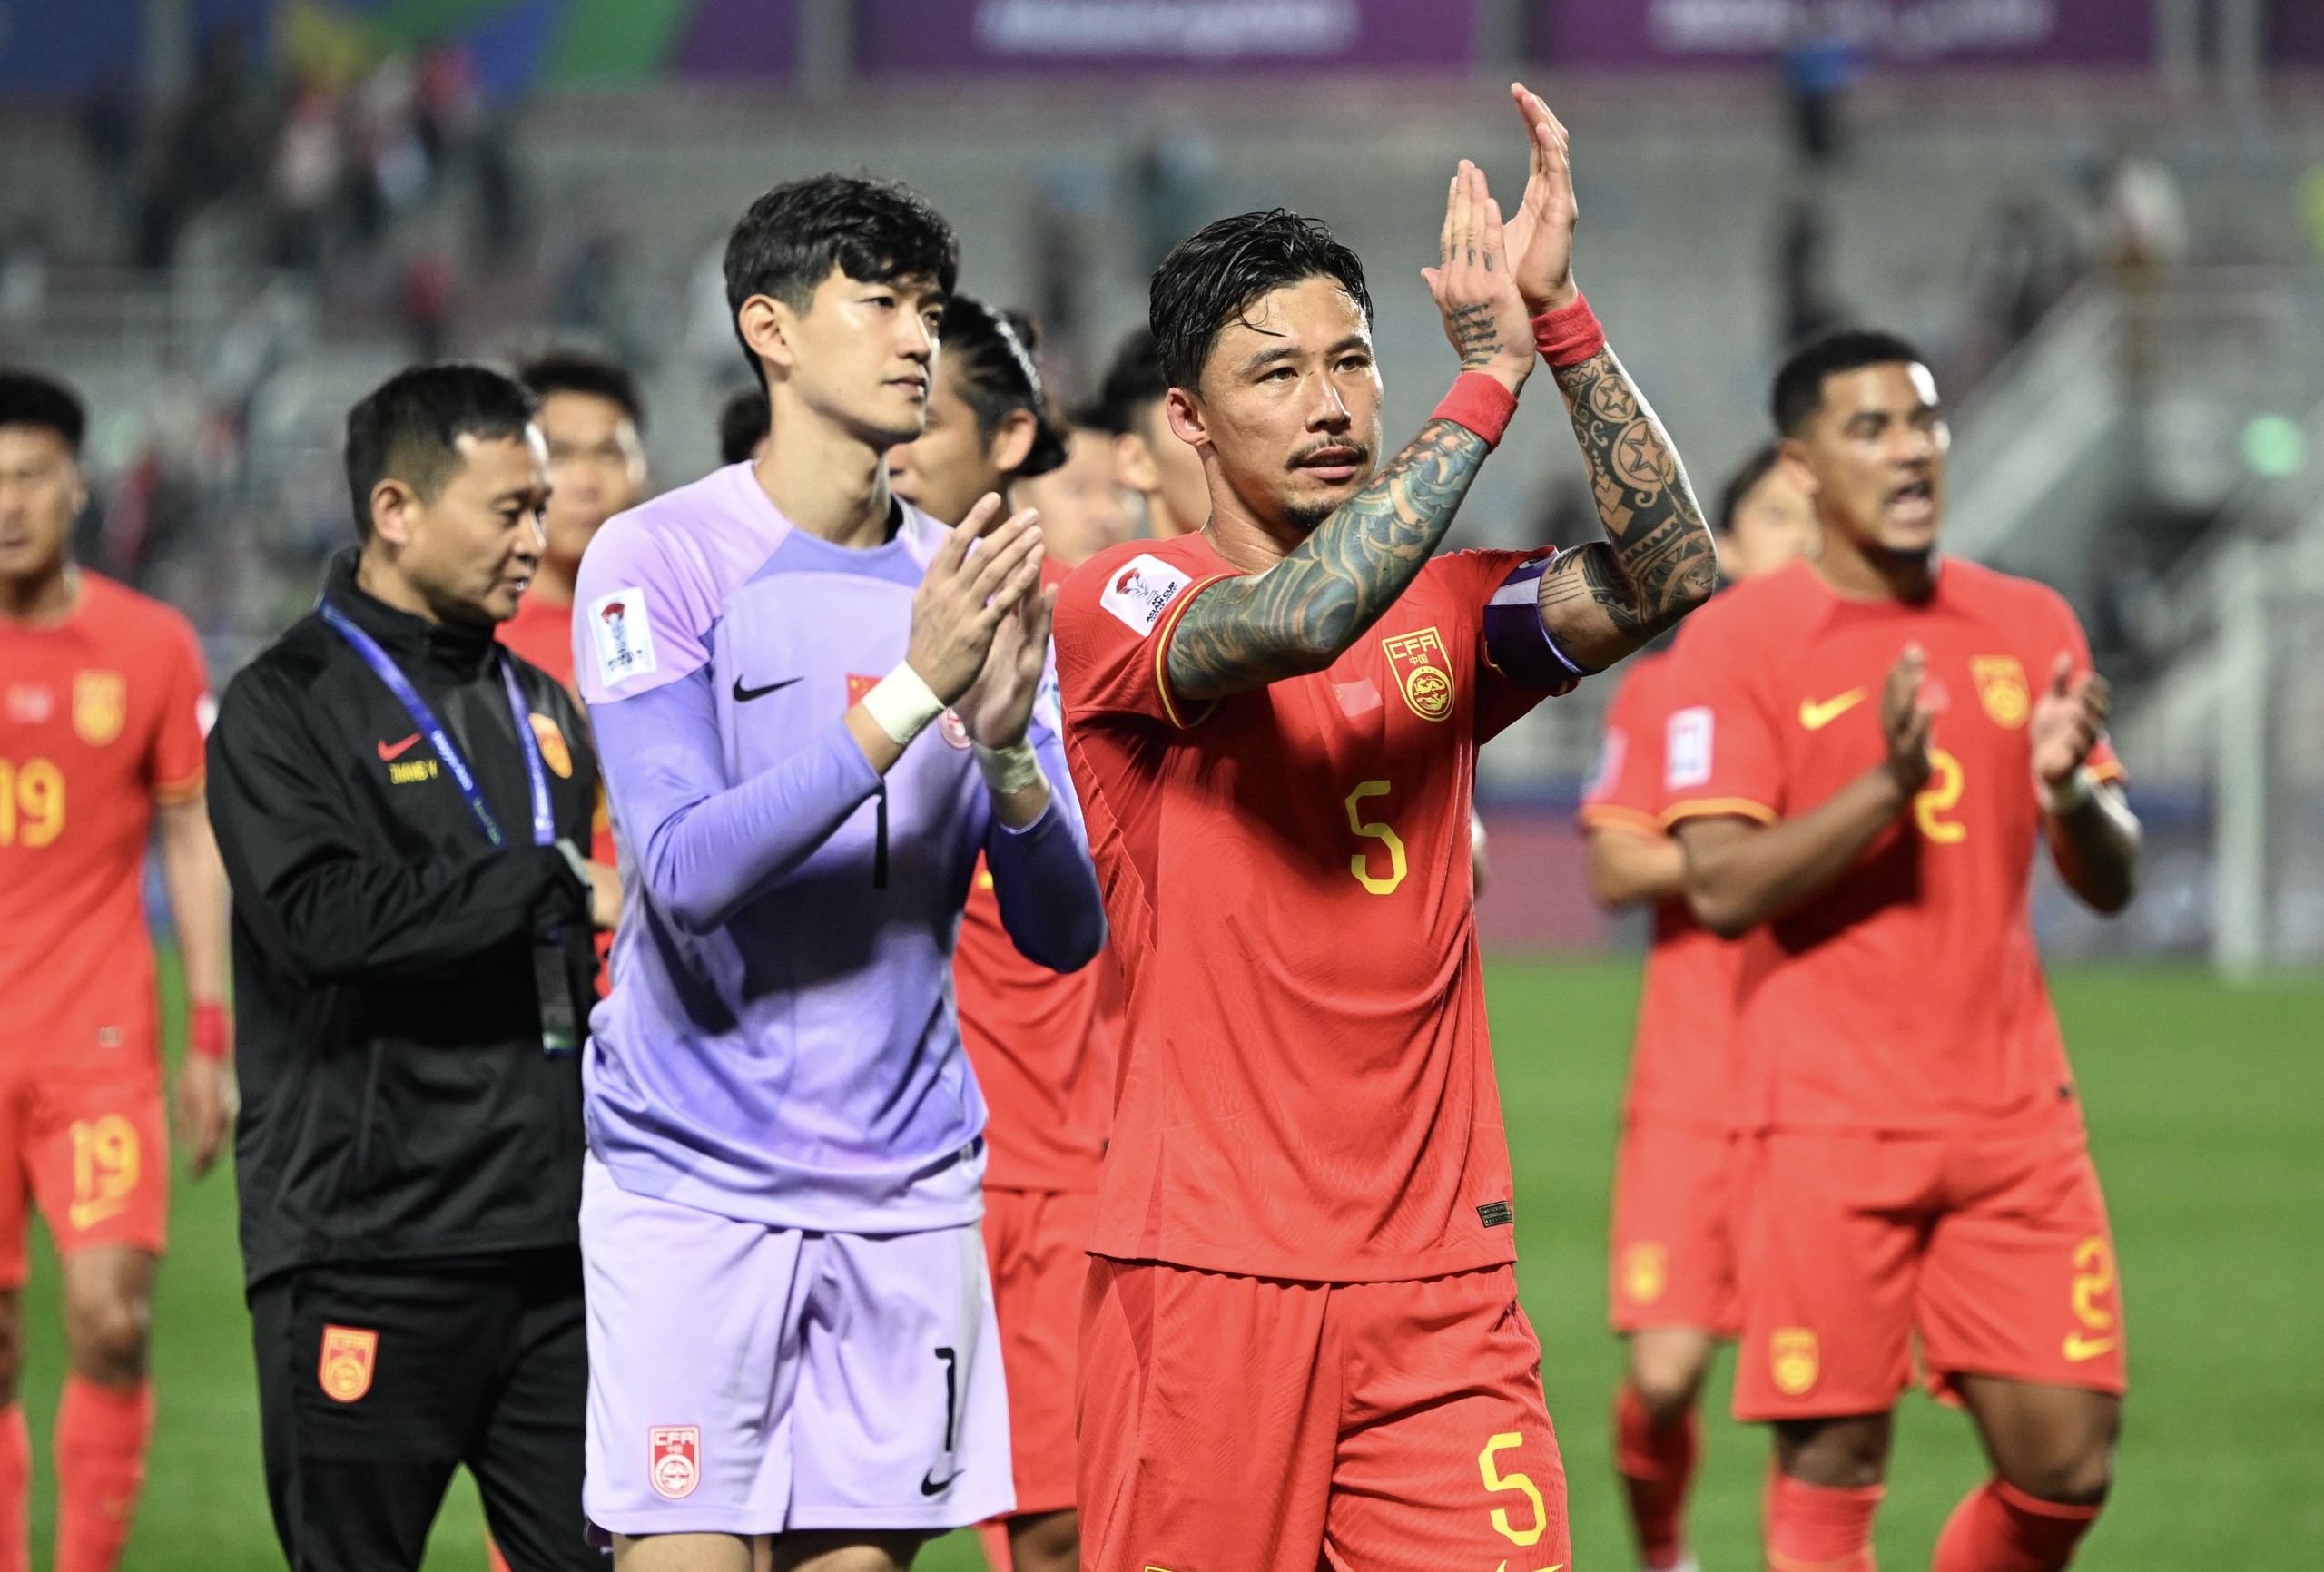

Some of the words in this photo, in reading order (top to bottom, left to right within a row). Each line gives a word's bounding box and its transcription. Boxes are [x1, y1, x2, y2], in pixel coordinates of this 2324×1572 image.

[1146, 598, 1165, 624] ASIAN
[1162, 581, 1176, 598] CUP
[1152, 593, 1162, 606] AFC
[1388, 634, 1438, 660] CFA
[0, 756, 66, 849] 19
[1344, 779, 1408, 896] 5
[1913, 747, 1968, 845] 2
[67, 1113, 141, 1202] 19
[2071, 1233, 2115, 1331] 2
[934, 1347, 957, 1452] 1
[1478, 1431, 1547, 1547] 5
